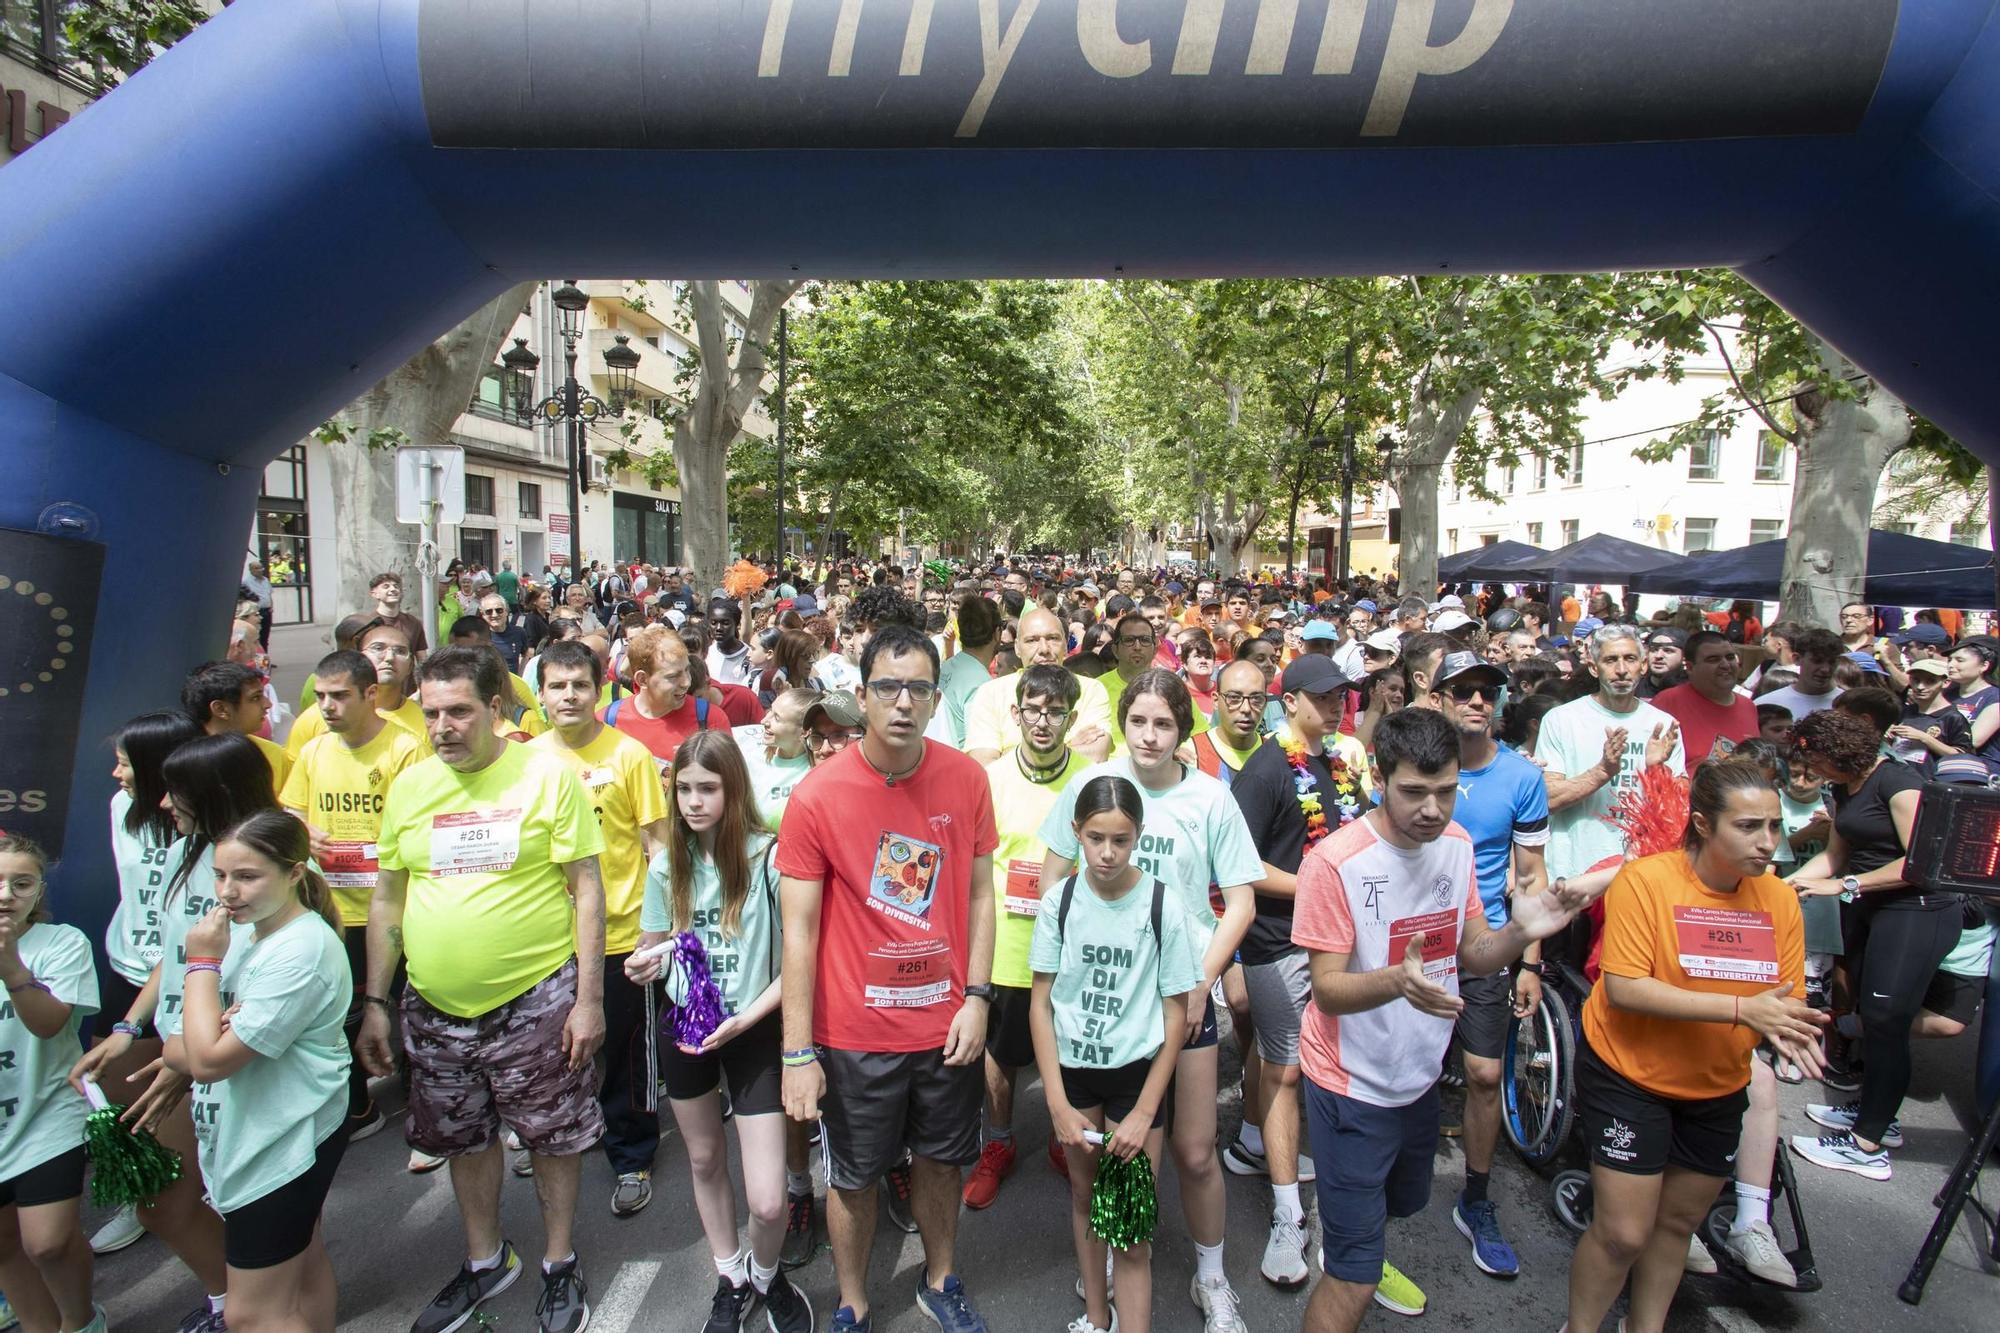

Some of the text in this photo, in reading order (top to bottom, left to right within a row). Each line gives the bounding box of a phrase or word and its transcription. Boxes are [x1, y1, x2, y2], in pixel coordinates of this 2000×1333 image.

[655, 500, 670, 514] SALA
[1622, 742, 1644, 755] OM
[460, 829, 490, 842] #261
[1133, 834, 1174, 856] OM
[140, 848, 168, 866] SO
[461, 862, 513, 874] DIVERSITAT
[184, 896, 222, 916] SO
[1363, 880, 1389, 920] 2F
[694, 908, 720, 928] SO
[865, 896, 932, 931] SOM DIVERSITAT
[132, 930, 162, 946] TA
[1708, 930, 1742, 944] #261
[708, 954, 739, 972] ER
[1082, 944, 1132, 968] SOM
[898, 960, 928, 974] #261
[1690, 968, 1768, 982] SOM DIVERSITAT
[1092, 968, 1116, 990] DI
[896, 994, 943, 1006] DIVERSITAT
[1082, 990, 1122, 1017] VER
[1082, 1018, 1106, 1040] SI
[1070, 1038, 1114, 1064] TAT
